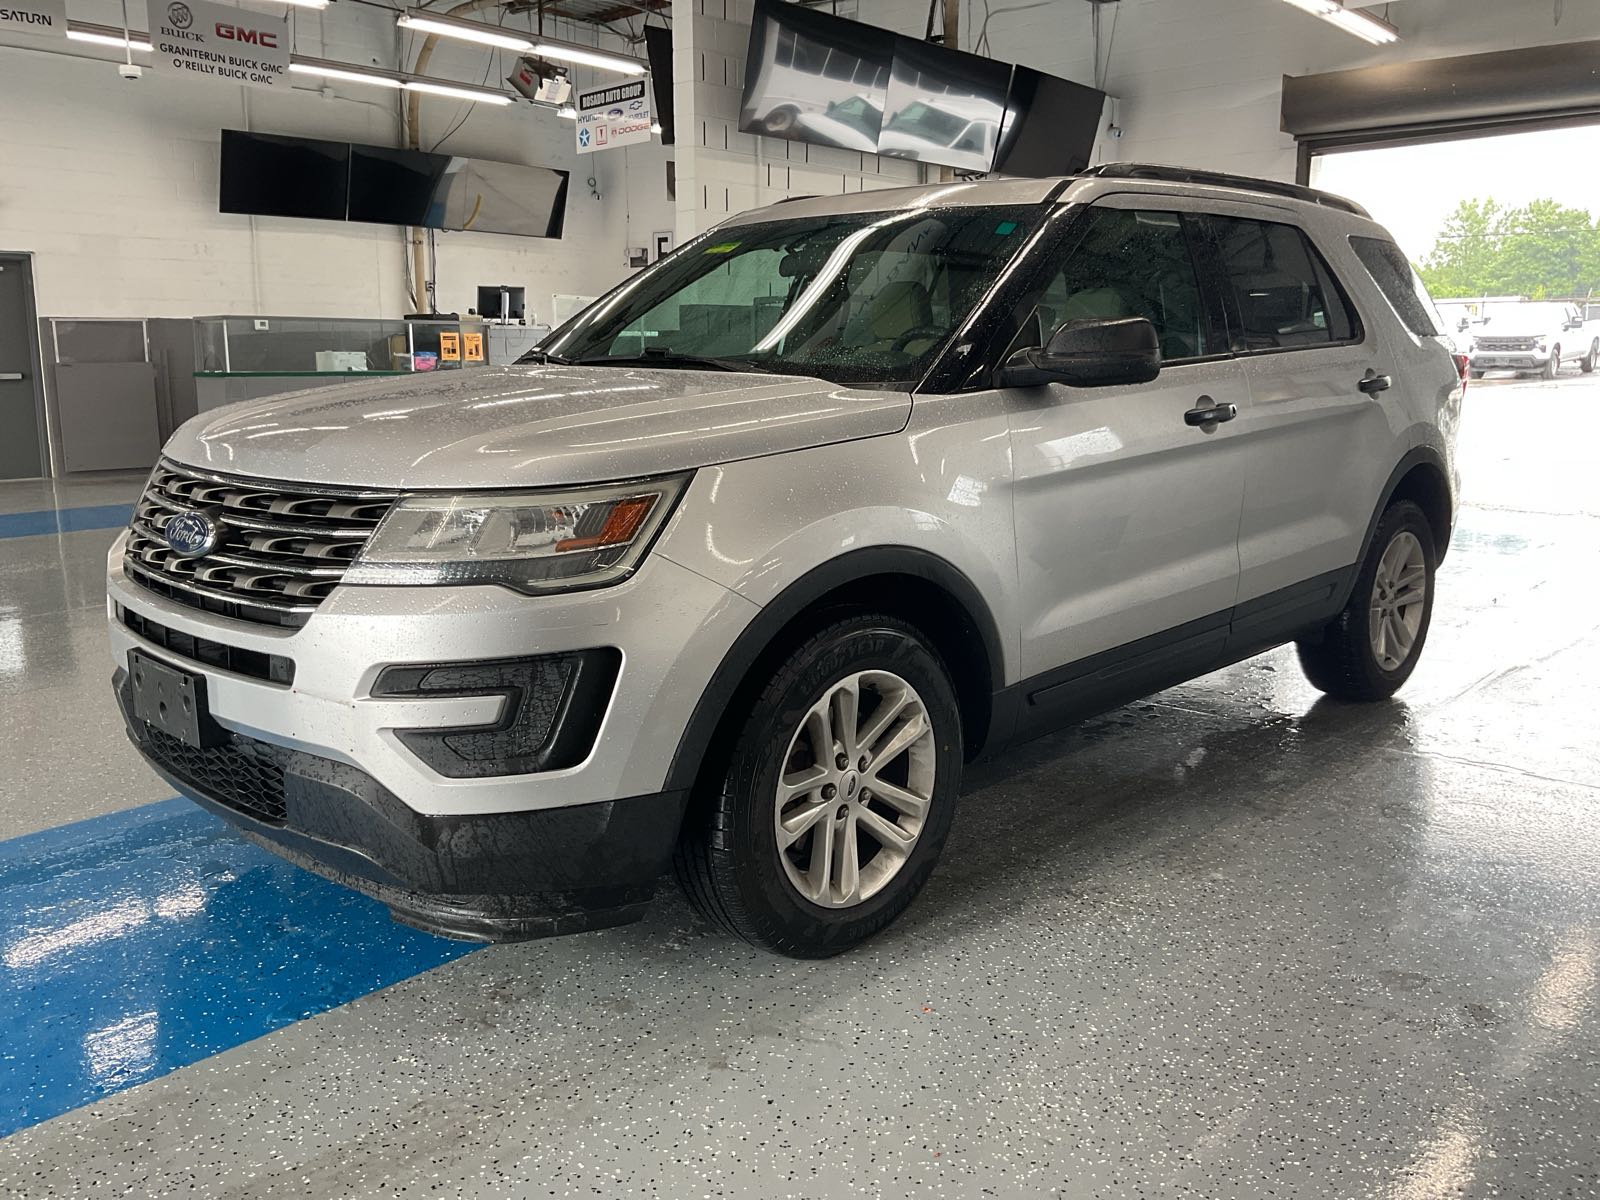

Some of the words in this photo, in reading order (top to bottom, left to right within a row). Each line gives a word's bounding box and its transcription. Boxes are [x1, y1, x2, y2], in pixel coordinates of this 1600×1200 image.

[0, 9, 52, 26] SATURN
[160, 26, 205, 43] BUICK
[215, 22, 278, 48] GMC
[159, 42, 226, 64] GRANITERUN
[228, 57, 258, 70] BUICK
[260, 62, 283, 75] GMC
[172, 58, 215, 74] O'REILLY
[218, 66, 248, 80] BUICK
[250, 73, 273, 85] GMC
[606, 88, 621, 103] AUTO
[621, 84, 642, 99] GROUP
[618, 122, 650, 135] DODGE
[170, 517, 199, 544] Ford
